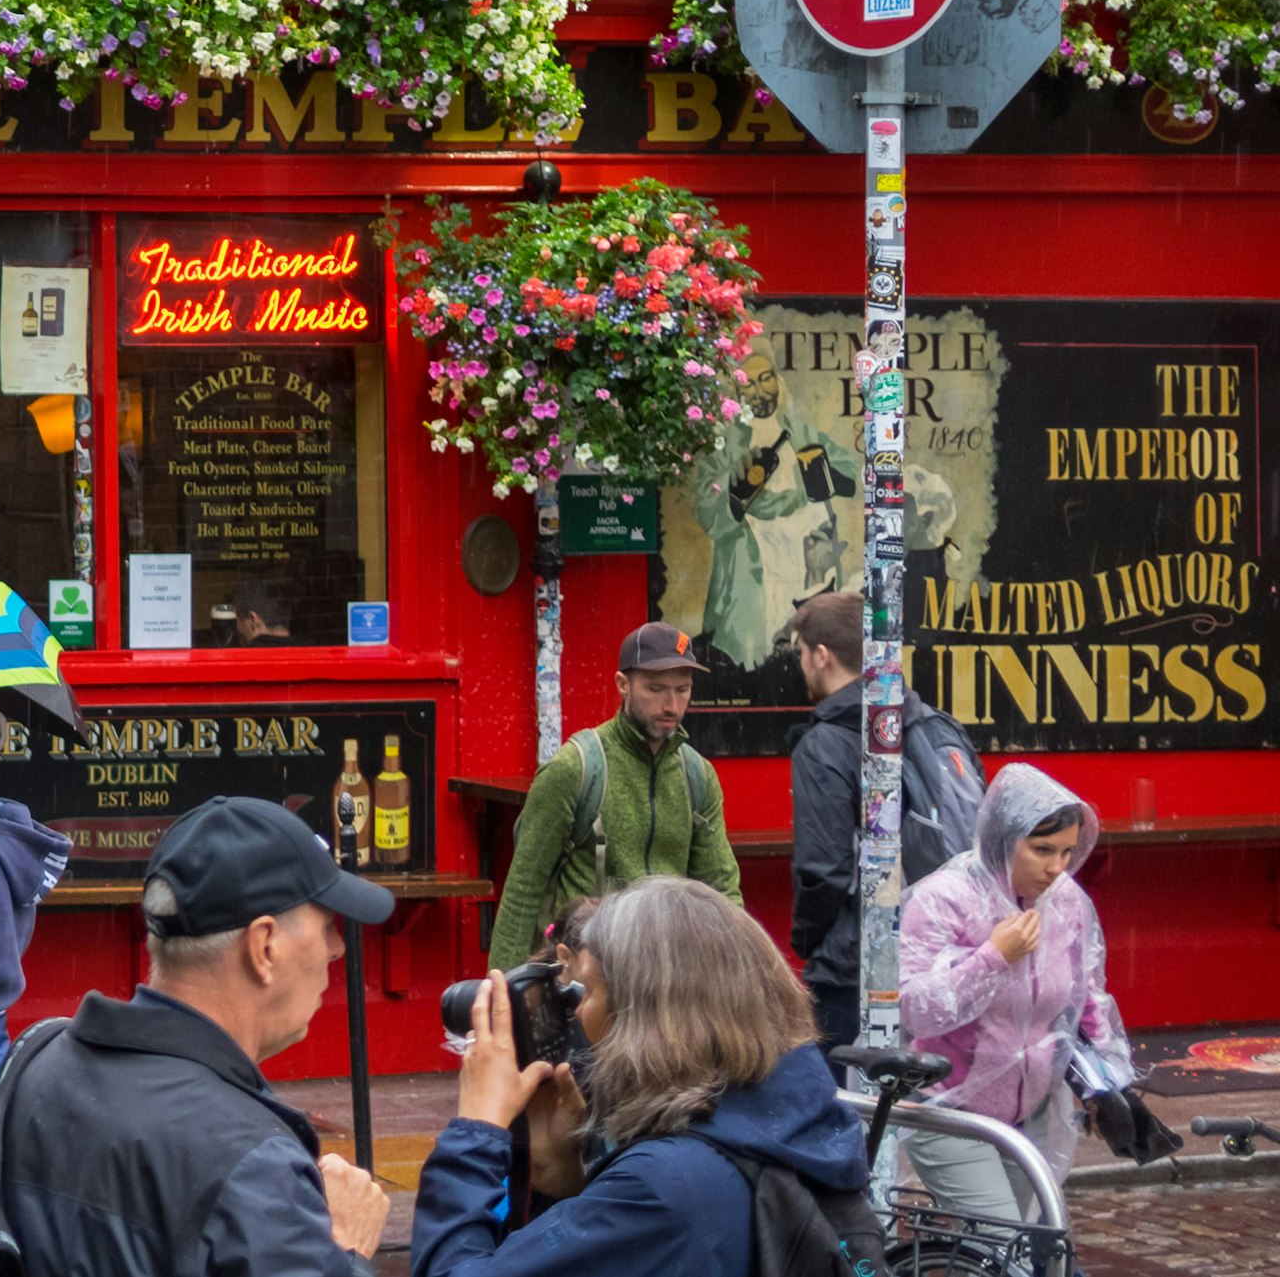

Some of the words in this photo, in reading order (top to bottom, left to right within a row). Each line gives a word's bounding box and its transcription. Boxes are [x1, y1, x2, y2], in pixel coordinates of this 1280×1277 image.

[647, 71, 808, 142] BA
[139, 235, 358, 285] Traditional
[133, 289, 232, 334] Irish
[255, 288, 369, 333] Music
[241, 351, 263, 362] The
[175, 365, 276, 412] TEMPLE
[284, 371, 332, 414] BAR
[839, 377, 943, 423] BR
[1156, 364, 1240, 417] THE
[173, 415, 255, 430] Traditional
[260, 415, 295, 430] Food
[301, 415, 332, 430] Fare
[183, 440, 212, 454] Meat
[217, 440, 249, 455] Plate,
[253, 440, 293, 454] Cheese
[297, 440, 332, 454] Board
[928, 426, 985, 451] 1840
[1045, 427, 1241, 482] EMPEROR
[168, 461, 200, 475] Fresh
[204, 461, 250, 480] Oysters,
[254, 461, 299, 475] Smoked
[304, 461, 346, 475] Salmon
[183, 482, 252, 496] Charcuterie
[257, 482, 293, 497] Meats,
[297, 481, 332, 495] Olives
[571, 486, 598, 496] Teach
[201, 502, 245, 516] Toasted
[249, 502, 315, 516] Sandwiches
[599, 499, 617, 510] Pub
[1195, 492, 1241, 544] OF
[197, 523, 219, 537] Hot
[224, 523, 255, 536] Roast
[260, 523, 285, 537] Beef
[291, 523, 318, 536] Rolls
[590, 526, 628, 535] APPROVED
[920, 577, 1086, 635] MALTED
[1094, 551, 1260, 625] LIQUORS
[234, 716, 325, 758] BAR
[87, 763, 178, 785] DUBLIN
[98, 791, 130, 808] EST.
[138, 790, 170, 807] 1840
